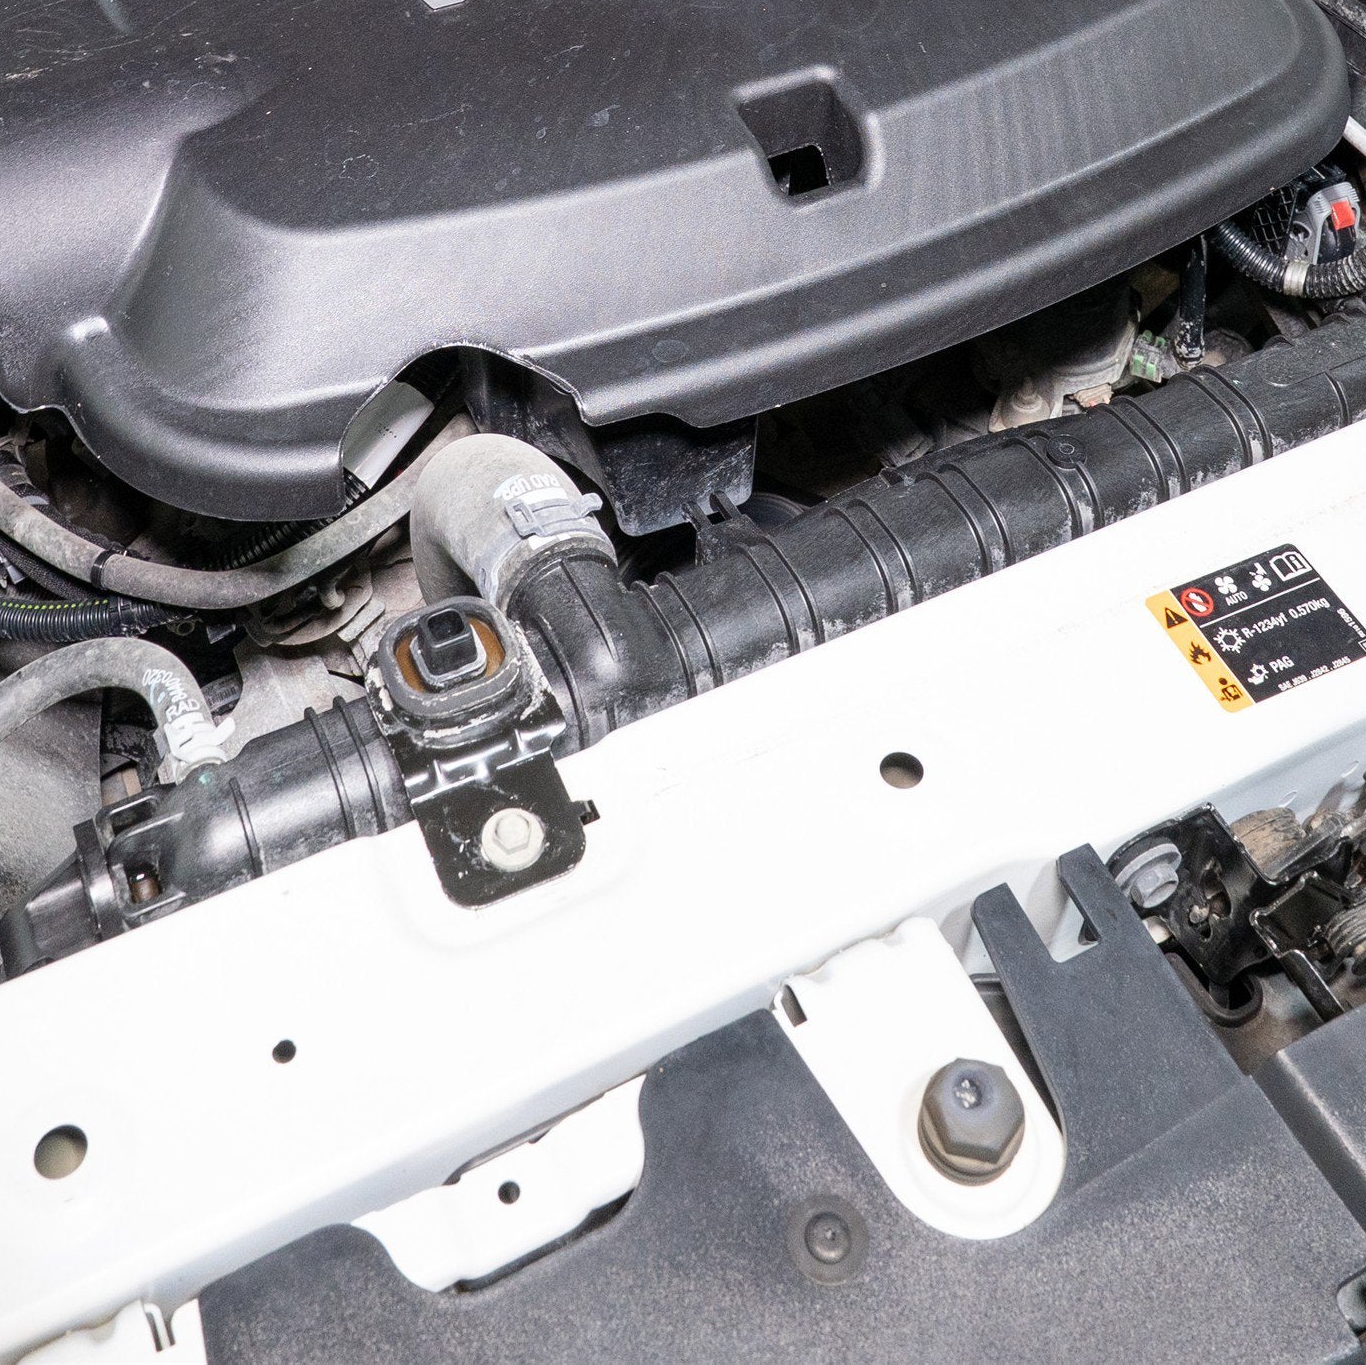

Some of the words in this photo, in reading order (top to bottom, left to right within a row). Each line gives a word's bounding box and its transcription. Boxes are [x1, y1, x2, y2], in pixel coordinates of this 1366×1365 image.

[1224, 591, 1249, 606] AUTO
[1240, 612, 1289, 639] R-1234yf
[1288, 597, 1331, 620] 0.570kg
[1268, 655, 1295, 674] PAG
[165, 699, 201, 723] RAD
